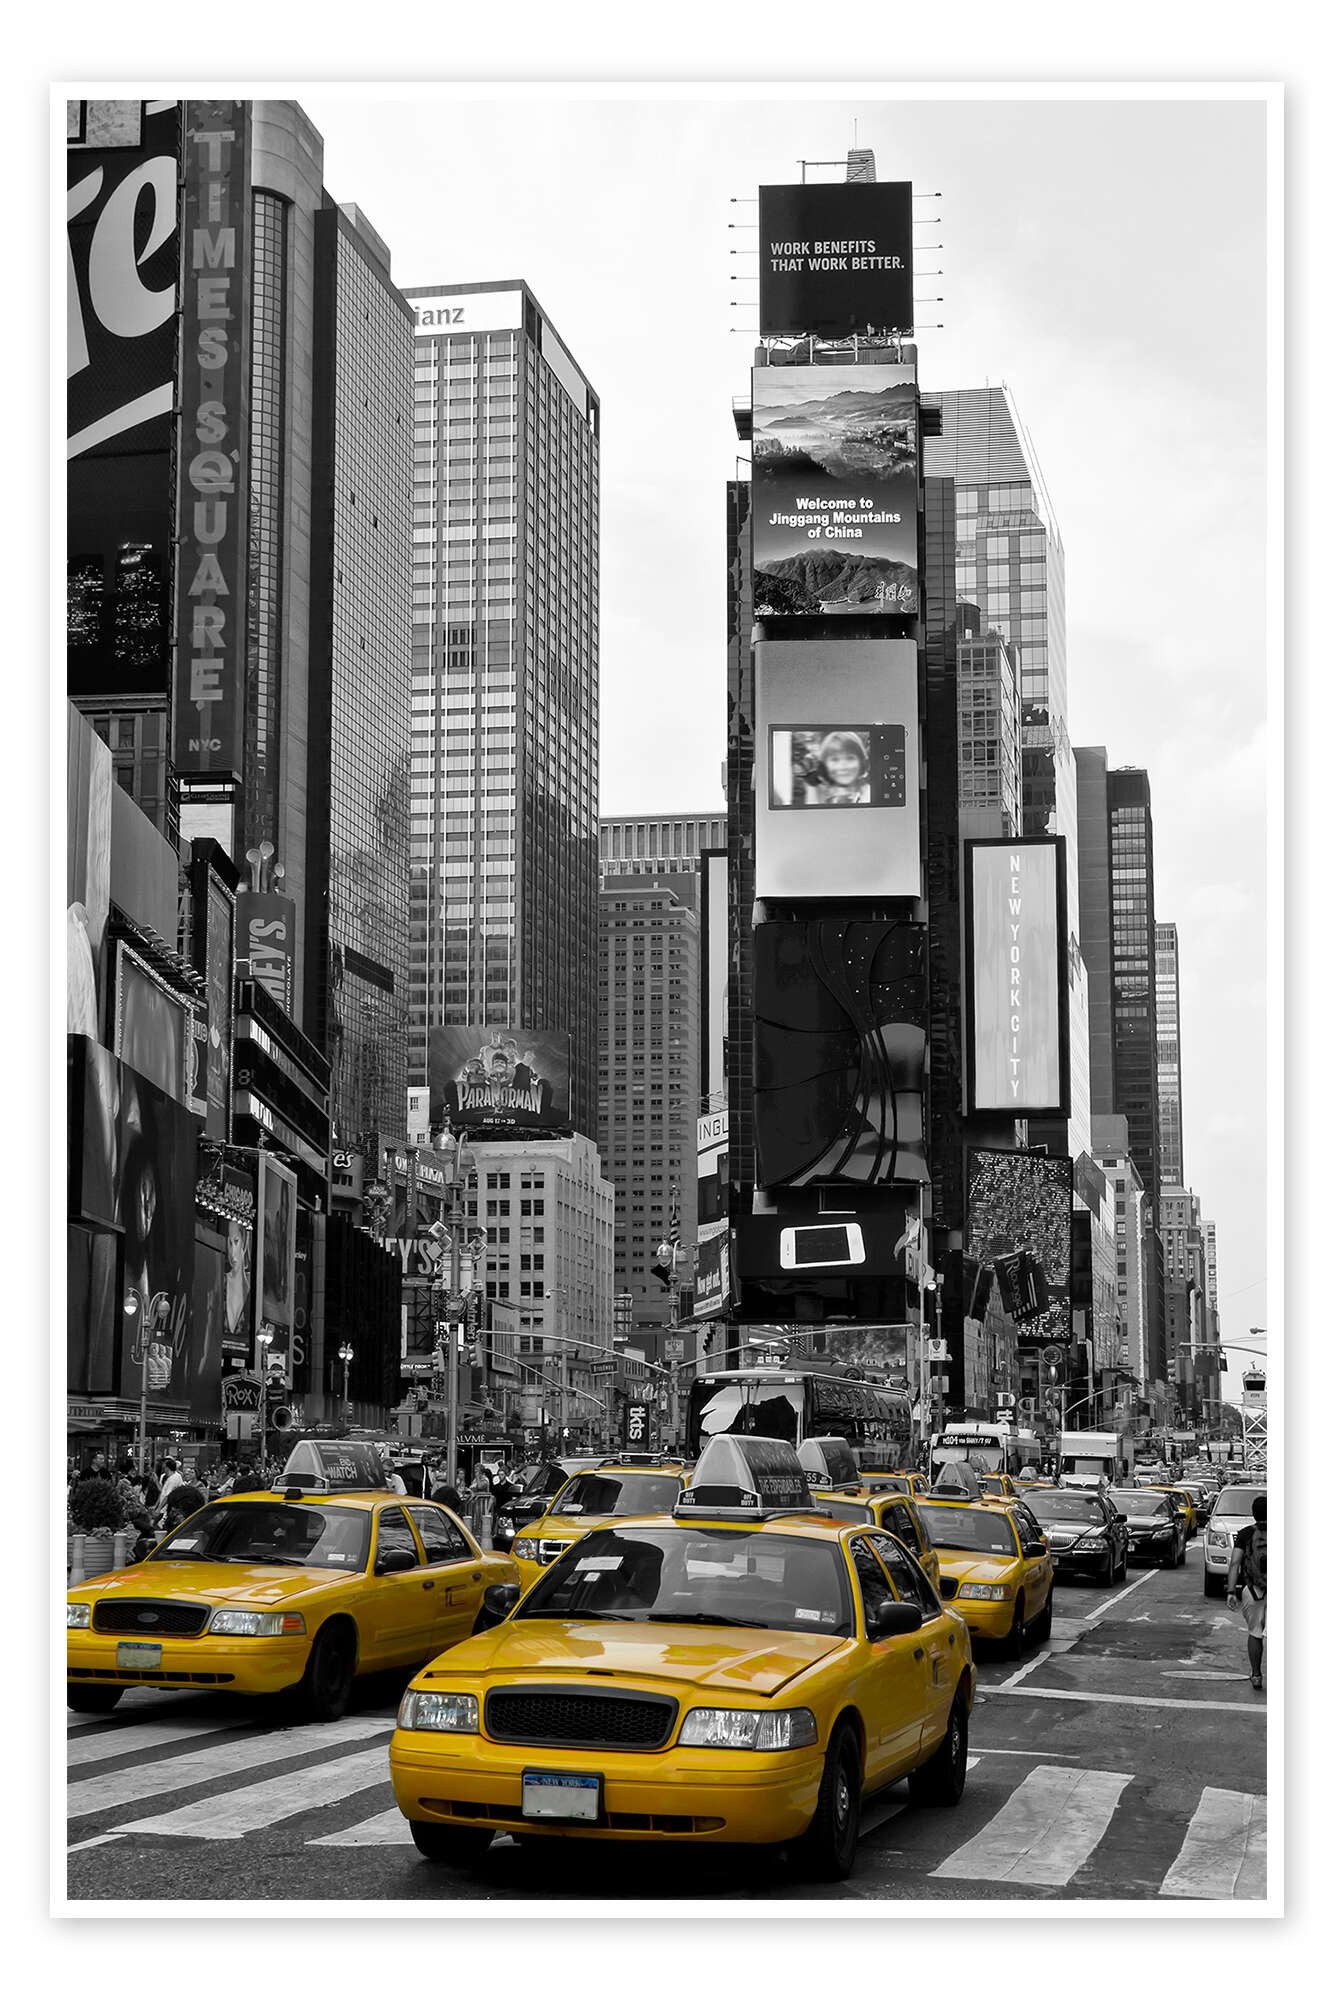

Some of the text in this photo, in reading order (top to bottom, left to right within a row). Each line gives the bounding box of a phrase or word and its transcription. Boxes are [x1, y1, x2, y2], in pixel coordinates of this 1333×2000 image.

[770, 240, 876, 255] WORK BENEFITS
[770, 256, 905, 271] THAT WORK BETTER.
[188, 130, 236, 701] TIMES SQUARE
[796, 497, 874, 510] Welcome to
[769, 511, 902, 528] Jinggang Mountains
[807, 526, 863, 538] of China
[188, 737, 222, 752] NYC
[1008, 855, 1021, 1098] NEW YORK CITY
[456, 1082, 543, 1115] PARANORMAN
[629, 1406, 647, 1440] tkts
[327, 1466, 358, 1479] WATCH
